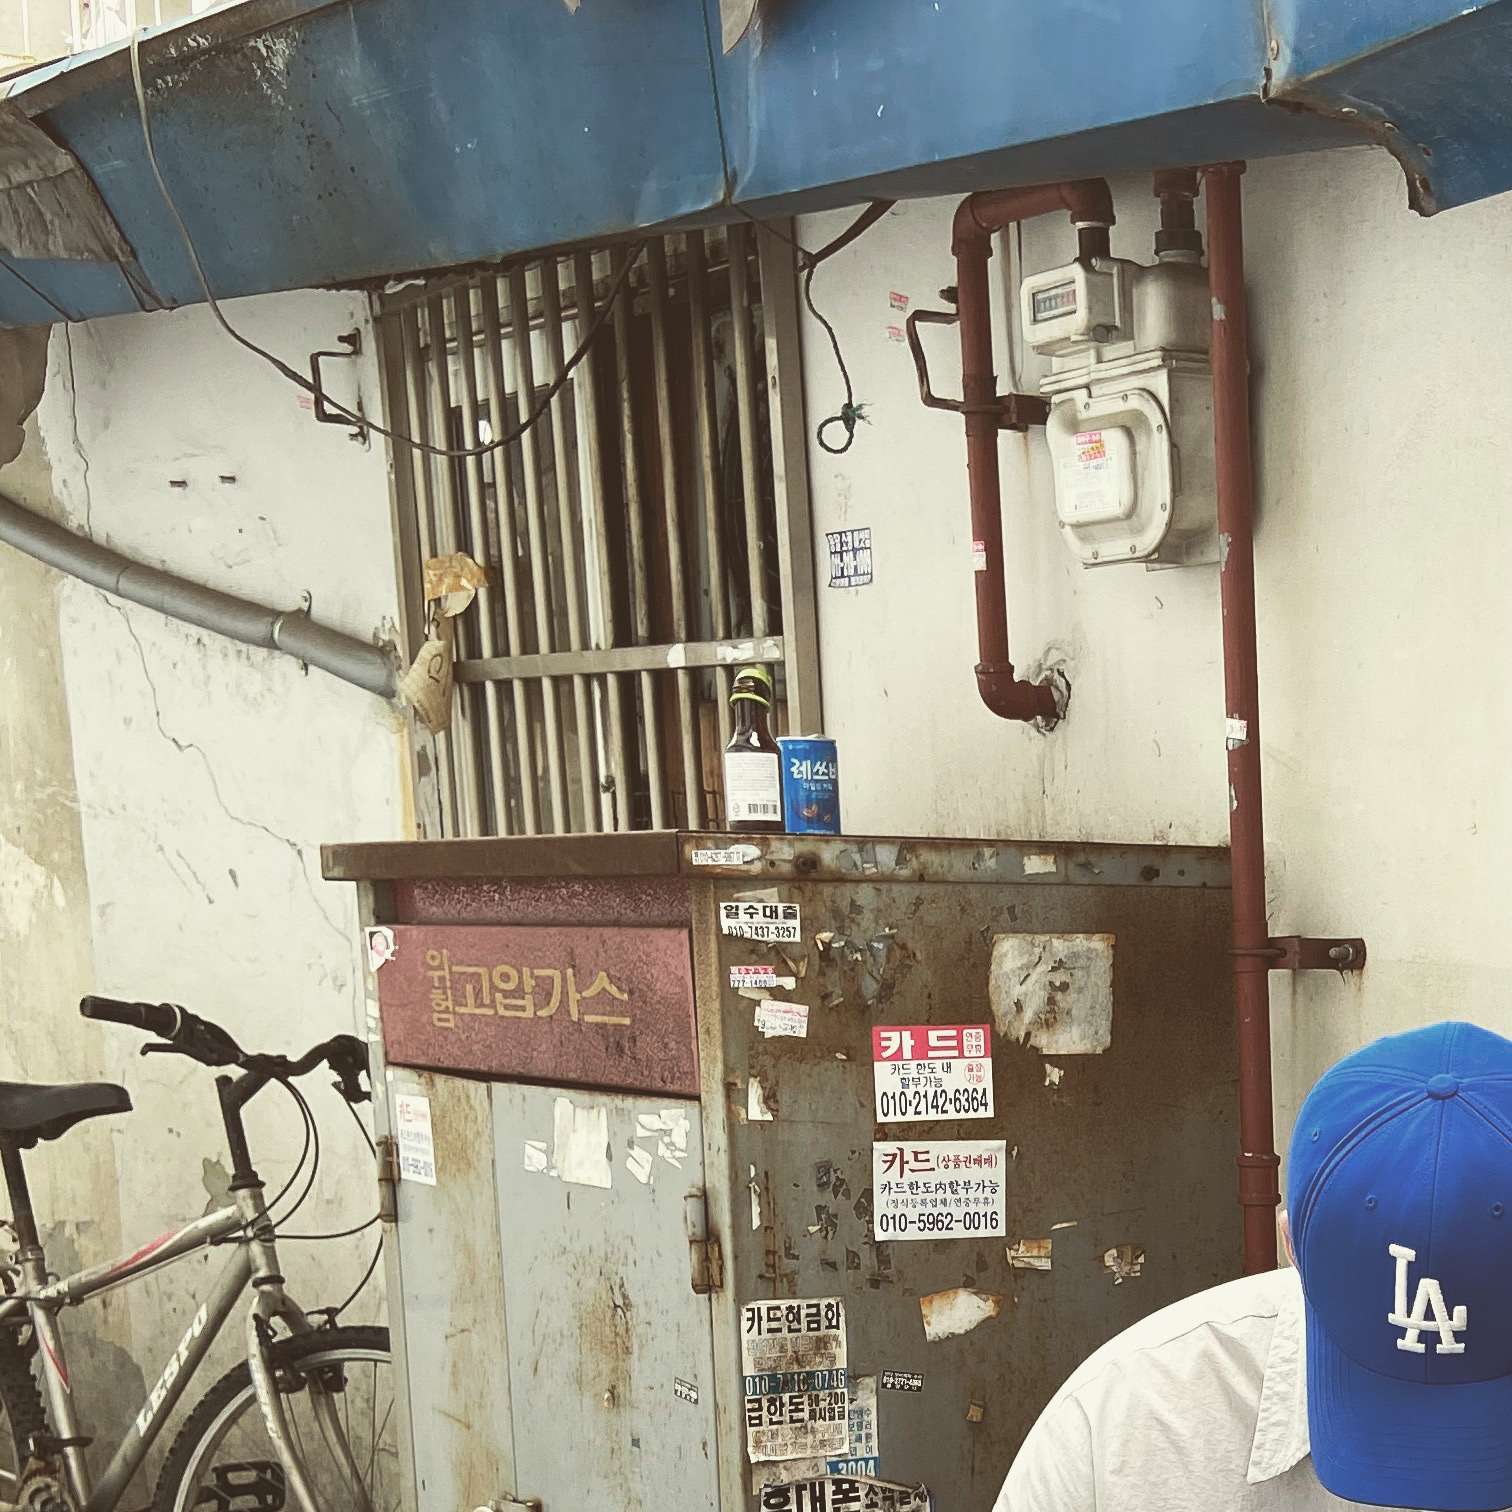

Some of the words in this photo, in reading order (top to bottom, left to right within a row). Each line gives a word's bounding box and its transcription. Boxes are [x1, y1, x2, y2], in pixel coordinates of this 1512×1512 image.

[451, 964, 632, 1026] 고압가스
[890, 1062, 911, 1076] 카드
[916, 1062, 938, 1075] 한도
[942, 1061, 952, 1074] 내
[881, 1146, 936, 1179] 카드
[880, 1210, 999, 1233] 010-5962-0016
[1388, 1243, 1468, 1354] LA
[745, 1302, 842, 1336] 카드현금화
[747, 1394, 805, 1428] 급한돈
